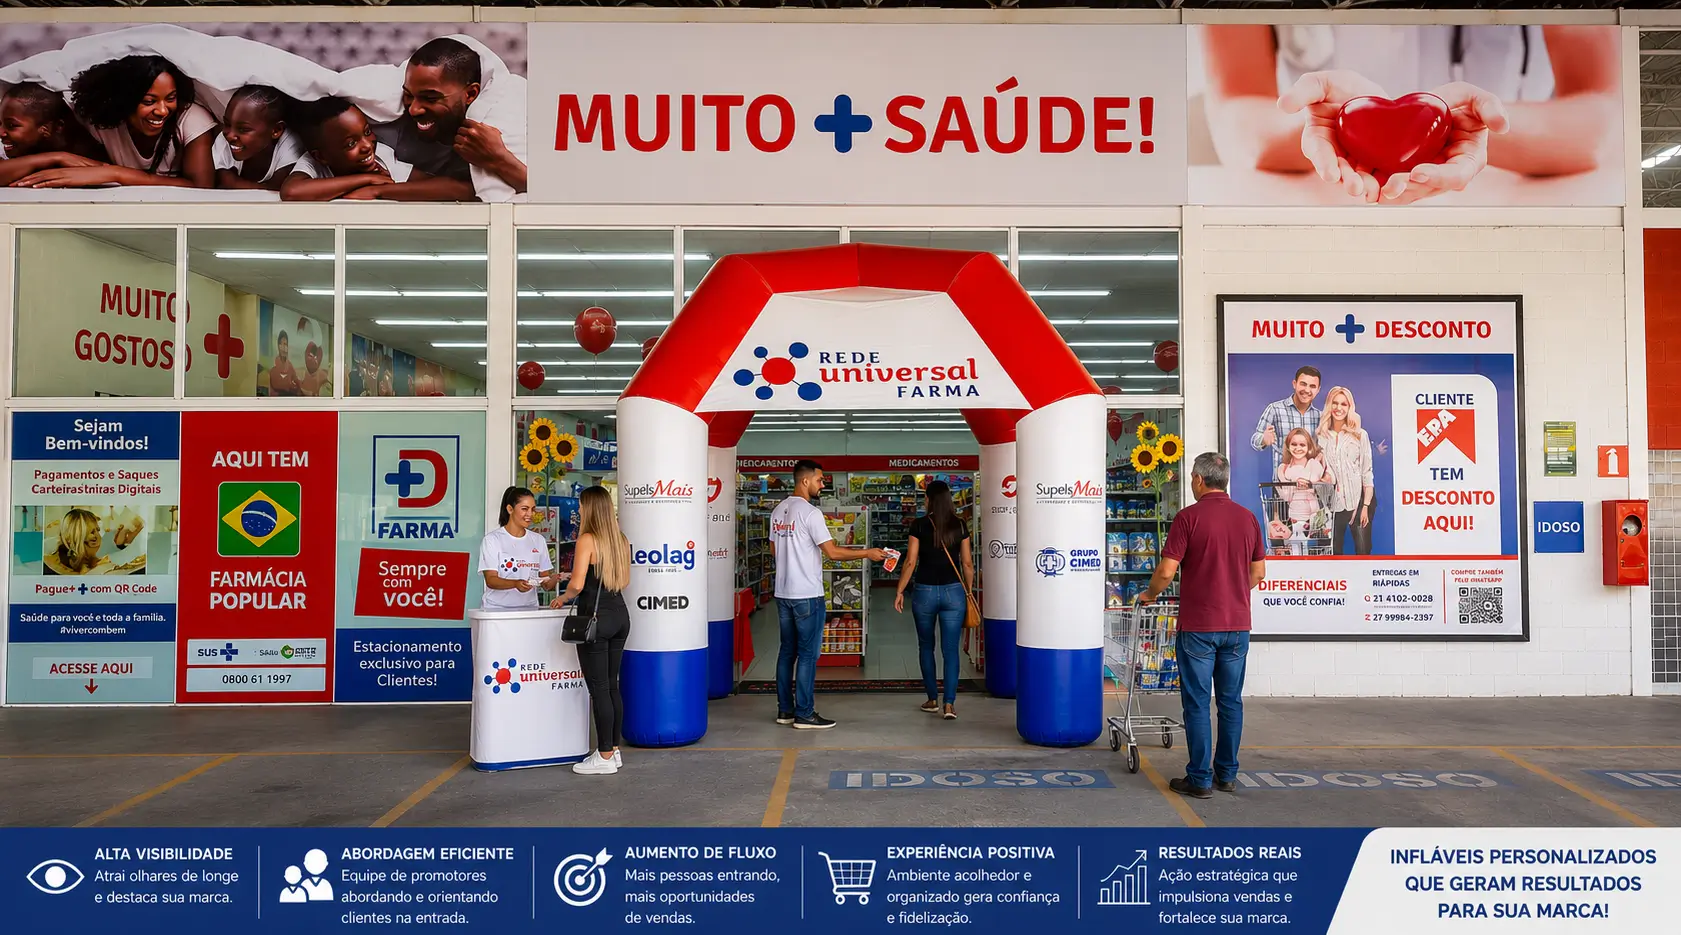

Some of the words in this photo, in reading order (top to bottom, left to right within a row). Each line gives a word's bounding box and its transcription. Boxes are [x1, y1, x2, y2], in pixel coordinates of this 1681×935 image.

[554, 94, 795, 153] MUITO
[884, 76, 1154, 154] SAÚDE!
[1252, 320, 1325, 338] MUITO
[1375, 320, 1491, 339] DESCONTO
[819, 352, 880, 364] REDE
[819, 358, 979, 383] universal
[897, 385, 980, 398] FARMA
[1416, 394, 1474, 405] CLIENTE
[74, 419, 122, 435] Sejam
[46, 436, 148, 450] Bem-vindos!
[212, 451, 262, 468] AQUI
[268, 451, 308, 467] TEM
[35, 470, 105, 482] Pagamentos
[118, 470, 158, 481] Saques
[1430, 468, 1463, 480] TEM
[118, 484, 161, 496] Digitais
[1402, 490, 1495, 505] DESCONTO
[378, 522, 455, 539] FARMA
[1424, 516, 1473, 532] AQUI!
[1538, 522, 1580, 532] IDOSO
[211, 567, 306, 587] FARMÁCIA
[378, 561, 447, 580] Sempre
[115, 584, 129, 593] QR
[132, 584, 157, 593] Code
[383, 578, 412, 588] com
[210, 592, 306, 609] POPULAR
[383, 587, 444, 607] você!
[637, 596, 689, 610] CIMED
[1264, 598, 1281, 607] QUE
[51, 615, 71, 623] para
[103, 613, 123, 621] toda
[354, 641, 461, 652] Estacionamento
[50, 663, 97, 674] ACESSE
[101, 663, 132, 675] AQUI
[360, 657, 421, 669] exclusivo
[426, 660, 454, 671] para
[520, 663, 546, 671] REDE
[222, 675, 248, 683] 0800
[251, 675, 261, 683] 61
[268, 675, 291, 683] 1997
[378, 674, 436, 686] Clientes!
[551, 681, 583, 690] FARMA
[846, 772, 1095, 787] IDOSO
